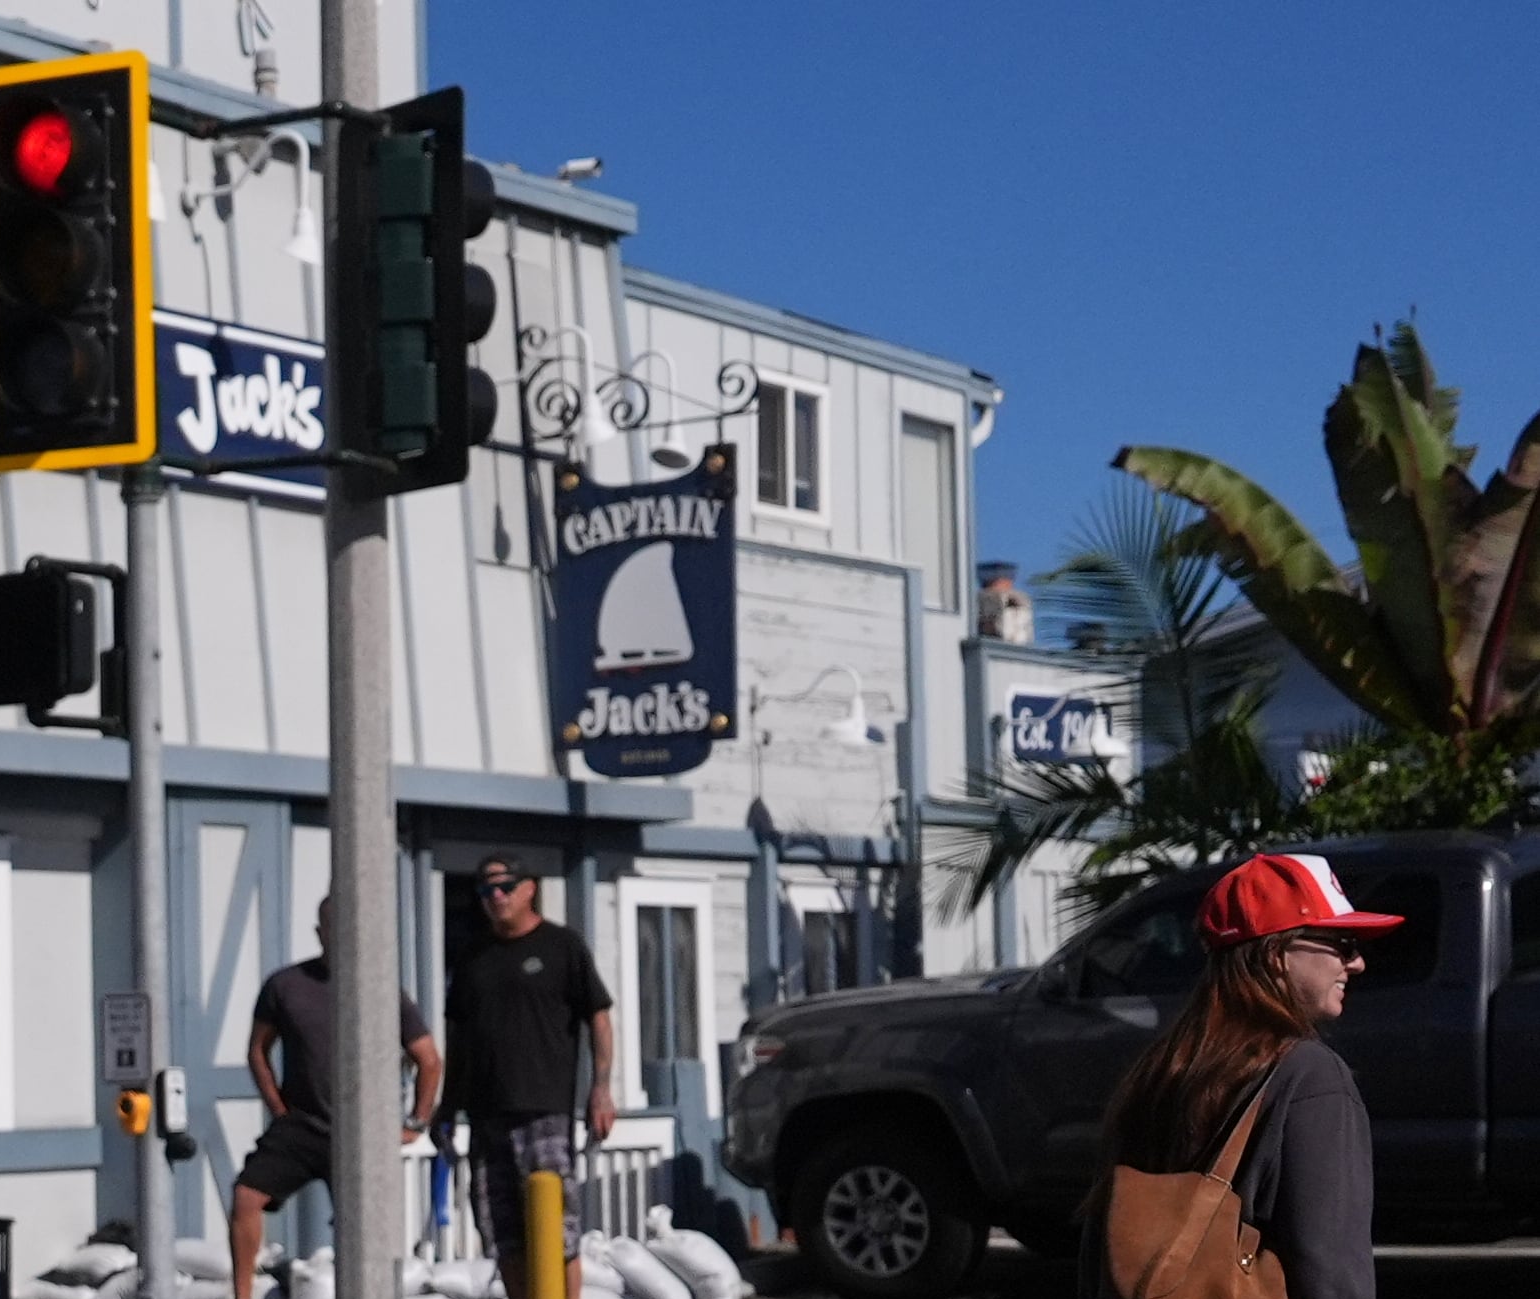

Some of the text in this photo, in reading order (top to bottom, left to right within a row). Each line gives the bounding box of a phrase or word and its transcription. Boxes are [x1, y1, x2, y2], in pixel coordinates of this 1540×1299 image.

[173, 342, 325, 453] Jack's
[563, 494, 724, 556] CAPTAIN
[578, 680, 712, 739] Jack's
